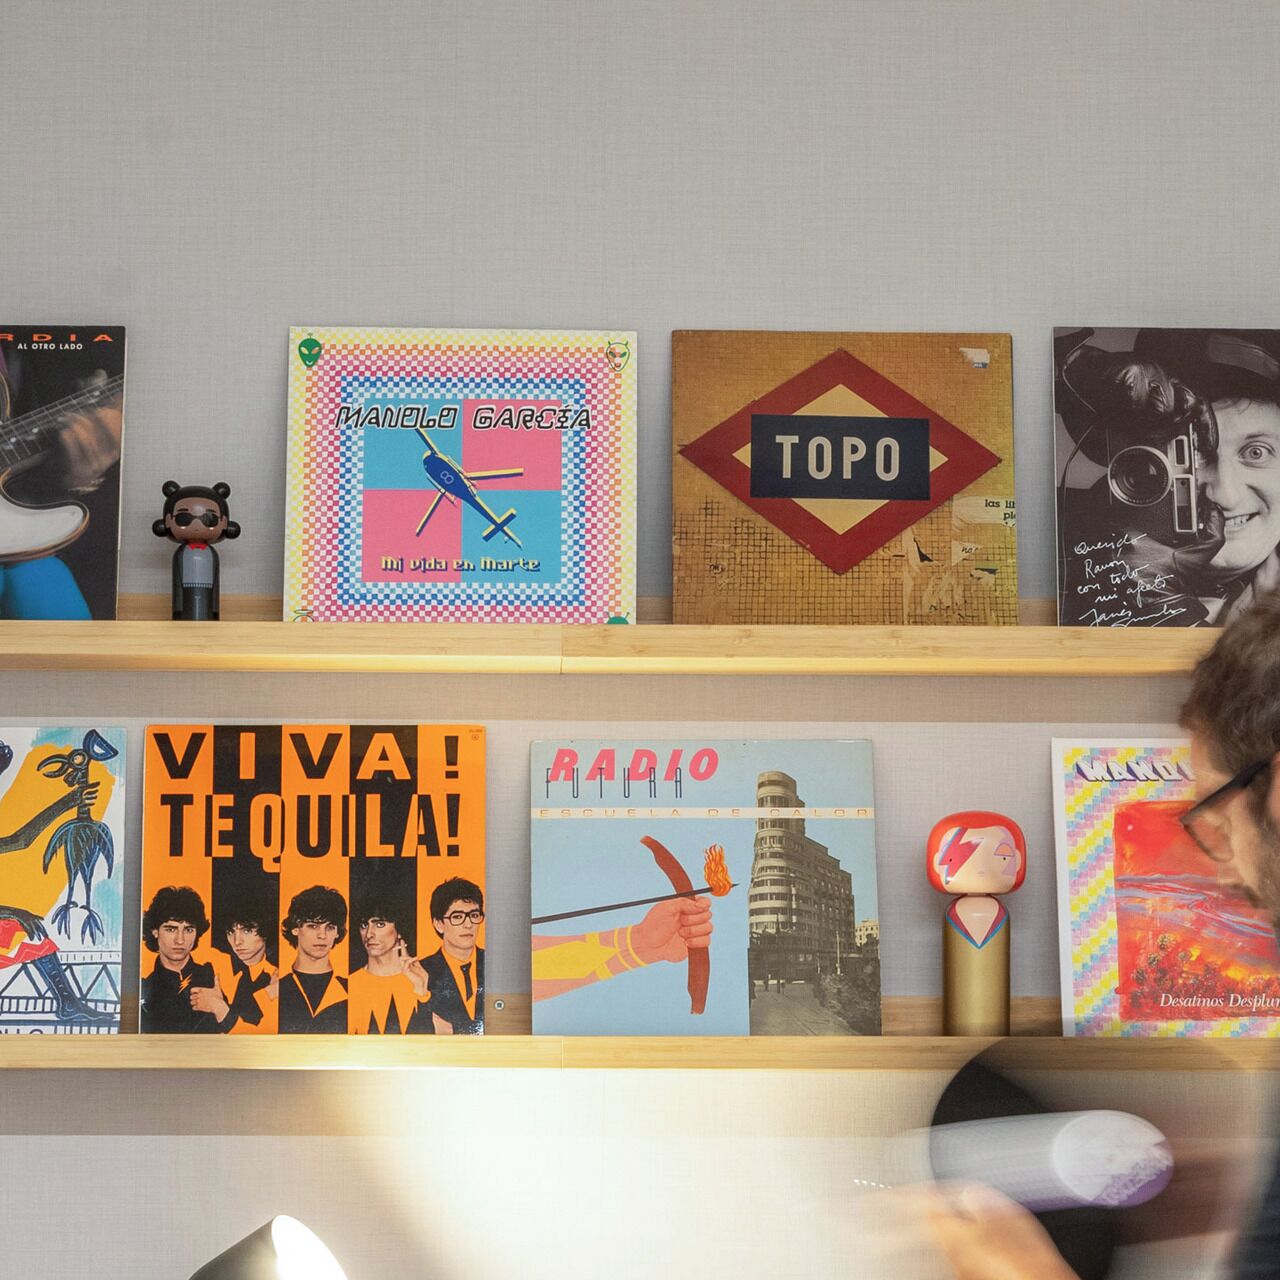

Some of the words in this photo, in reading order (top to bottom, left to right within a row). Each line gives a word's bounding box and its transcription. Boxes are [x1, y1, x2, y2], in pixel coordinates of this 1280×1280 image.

[17, 343, 29, 351] AL
[31, 343, 56, 351] OTRO
[59, 343, 83, 351] LADO
[335, 405, 458, 430] MANOLO
[472, 404, 592, 431] GARCÍA
[775, 434, 900, 482] TOPO
[984, 499, 1001, 508] las
[452, 557, 476, 572] en
[548, 747, 719, 782] RADIO
[545, 767, 683, 799] FUTURA
[539, 808, 681, 817] ESCUELA
[708, 808, 741, 817] DE
[770, 808, 870, 817] CALOR
[160, 793, 461, 873] TEQUILA!
[1159, 994, 1224, 1008] Desatinos
